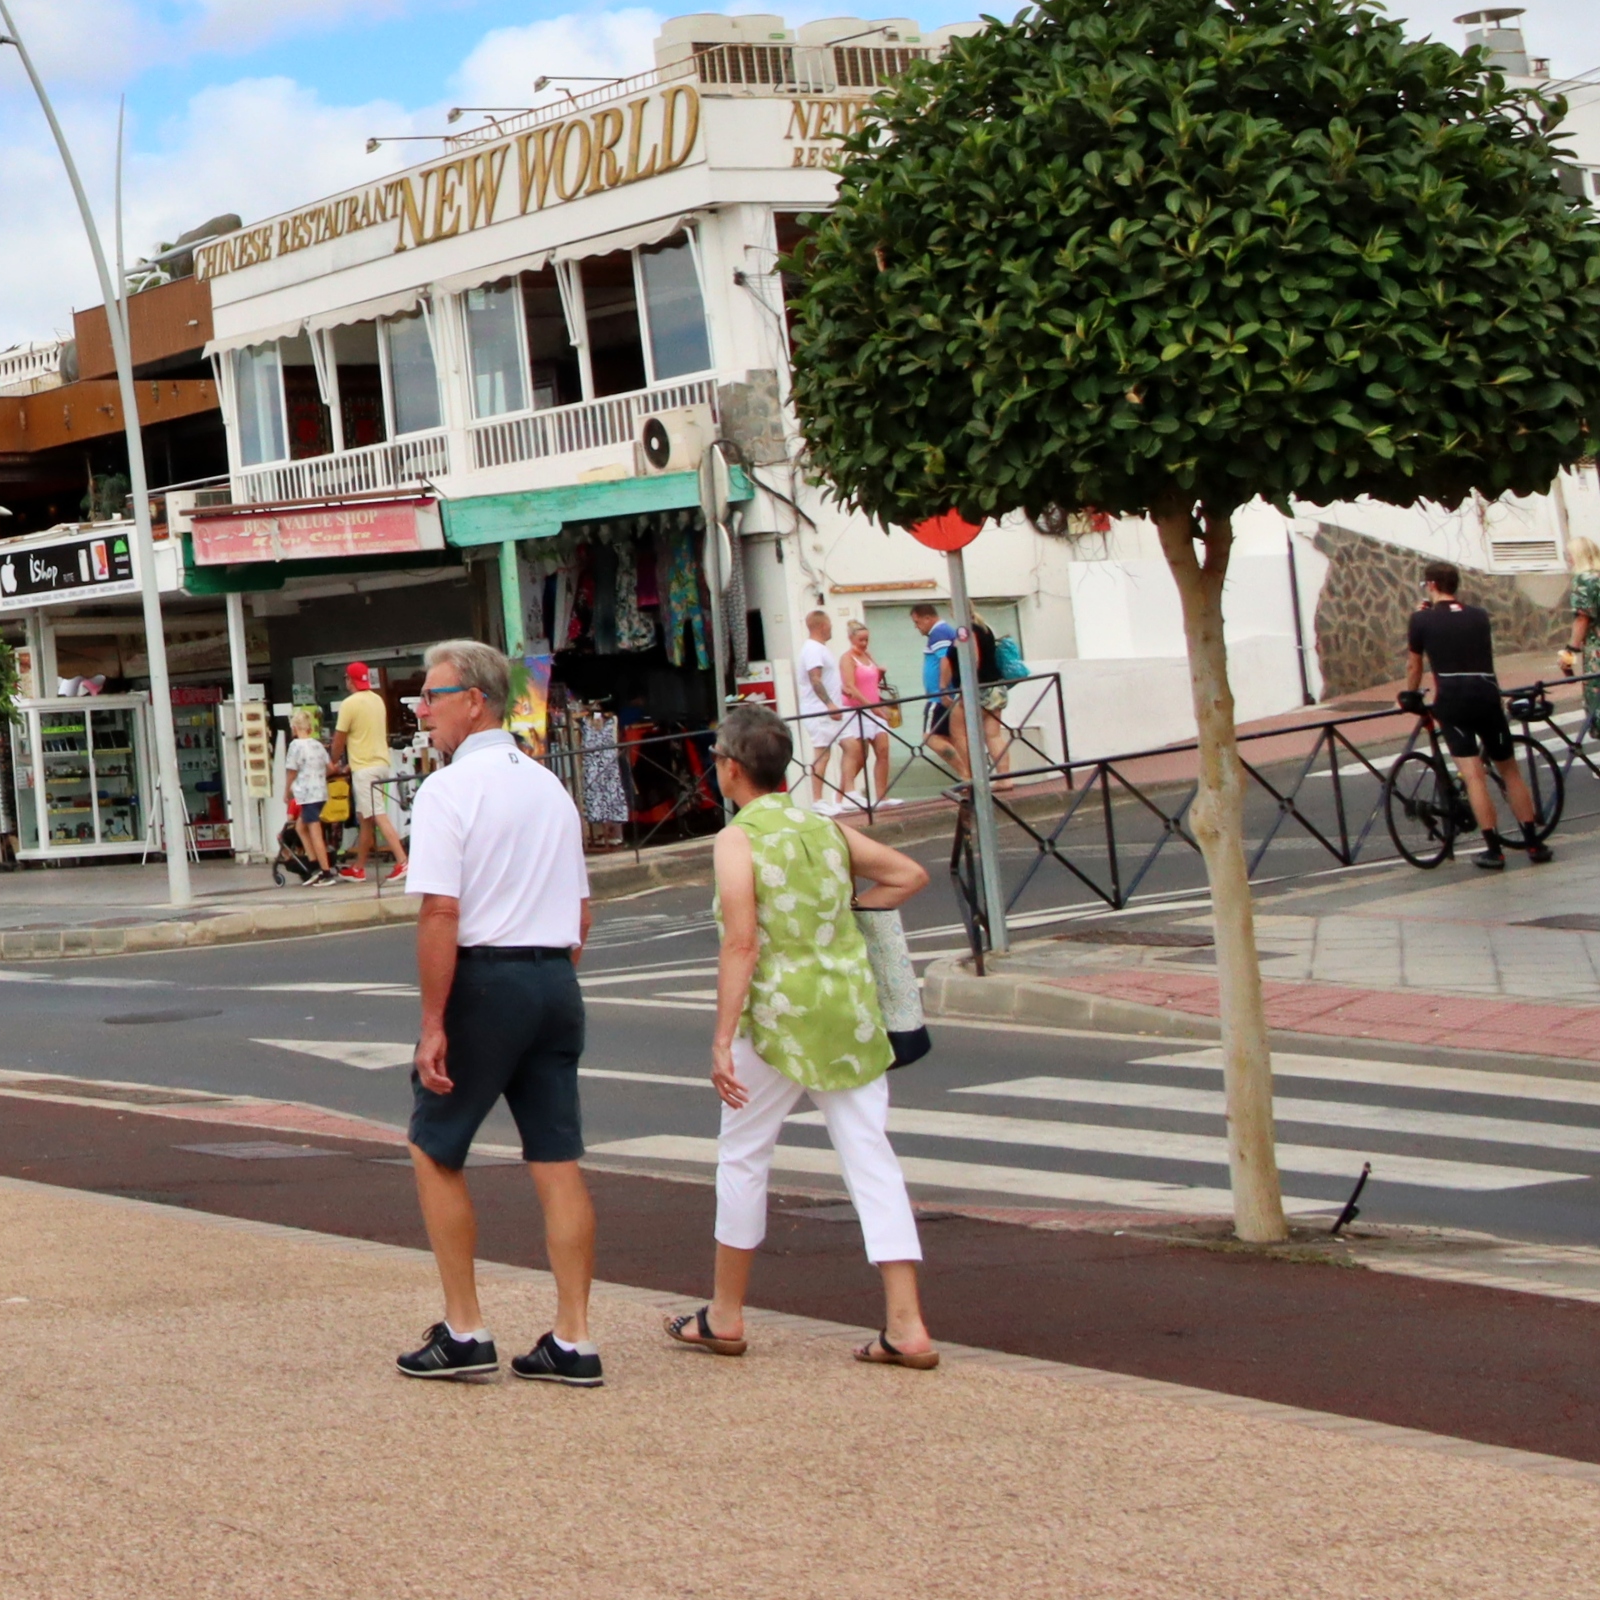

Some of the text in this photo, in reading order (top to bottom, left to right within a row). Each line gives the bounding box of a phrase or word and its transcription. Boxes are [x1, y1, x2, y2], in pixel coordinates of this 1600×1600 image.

[194, 84, 699, 284] CHINESE RESTAURANT NEW WORLD
[285, 513, 332, 530] VALUE
[335, 509, 378, 526] SHOP
[29, 553, 59, 587] iShop
